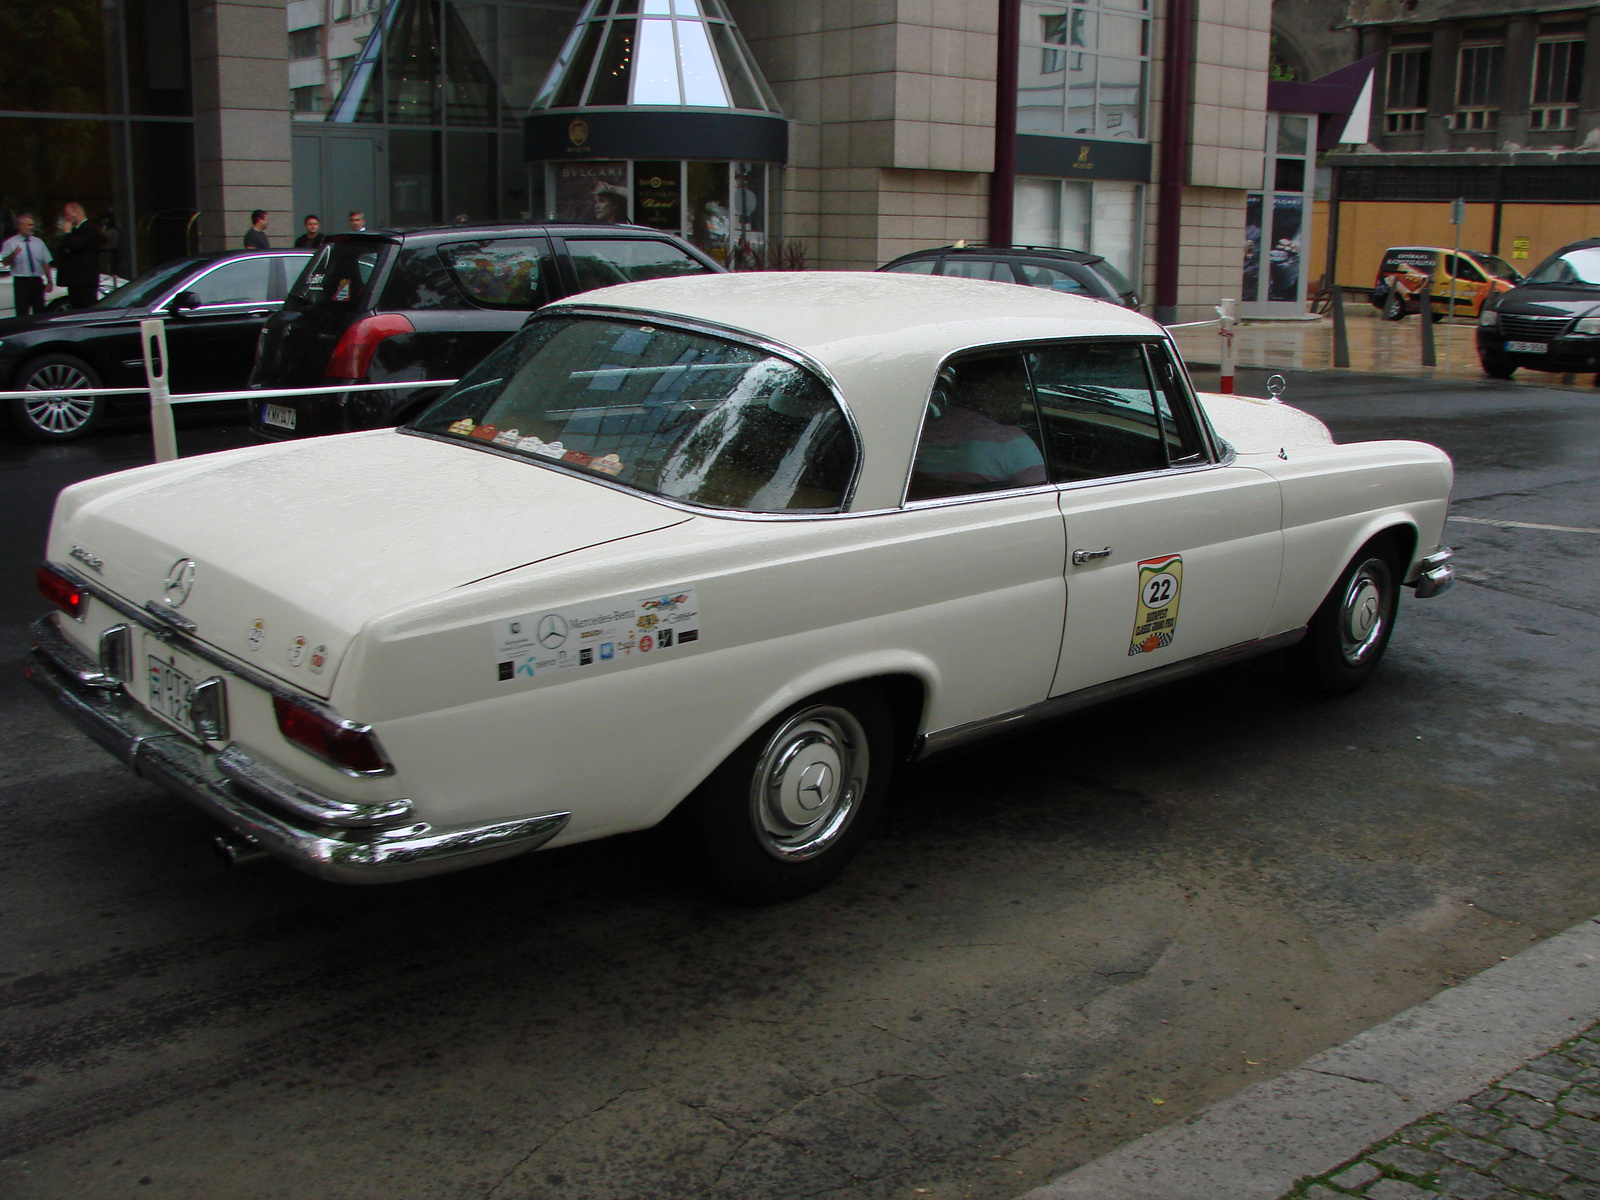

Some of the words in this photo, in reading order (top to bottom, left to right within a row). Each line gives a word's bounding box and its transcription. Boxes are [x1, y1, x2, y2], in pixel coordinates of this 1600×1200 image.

[561, 167, 623, 178] BVLGARI
[1149, 579, 1170, 603] 22
[569, 608, 636, 630] Mercedes-Benz
